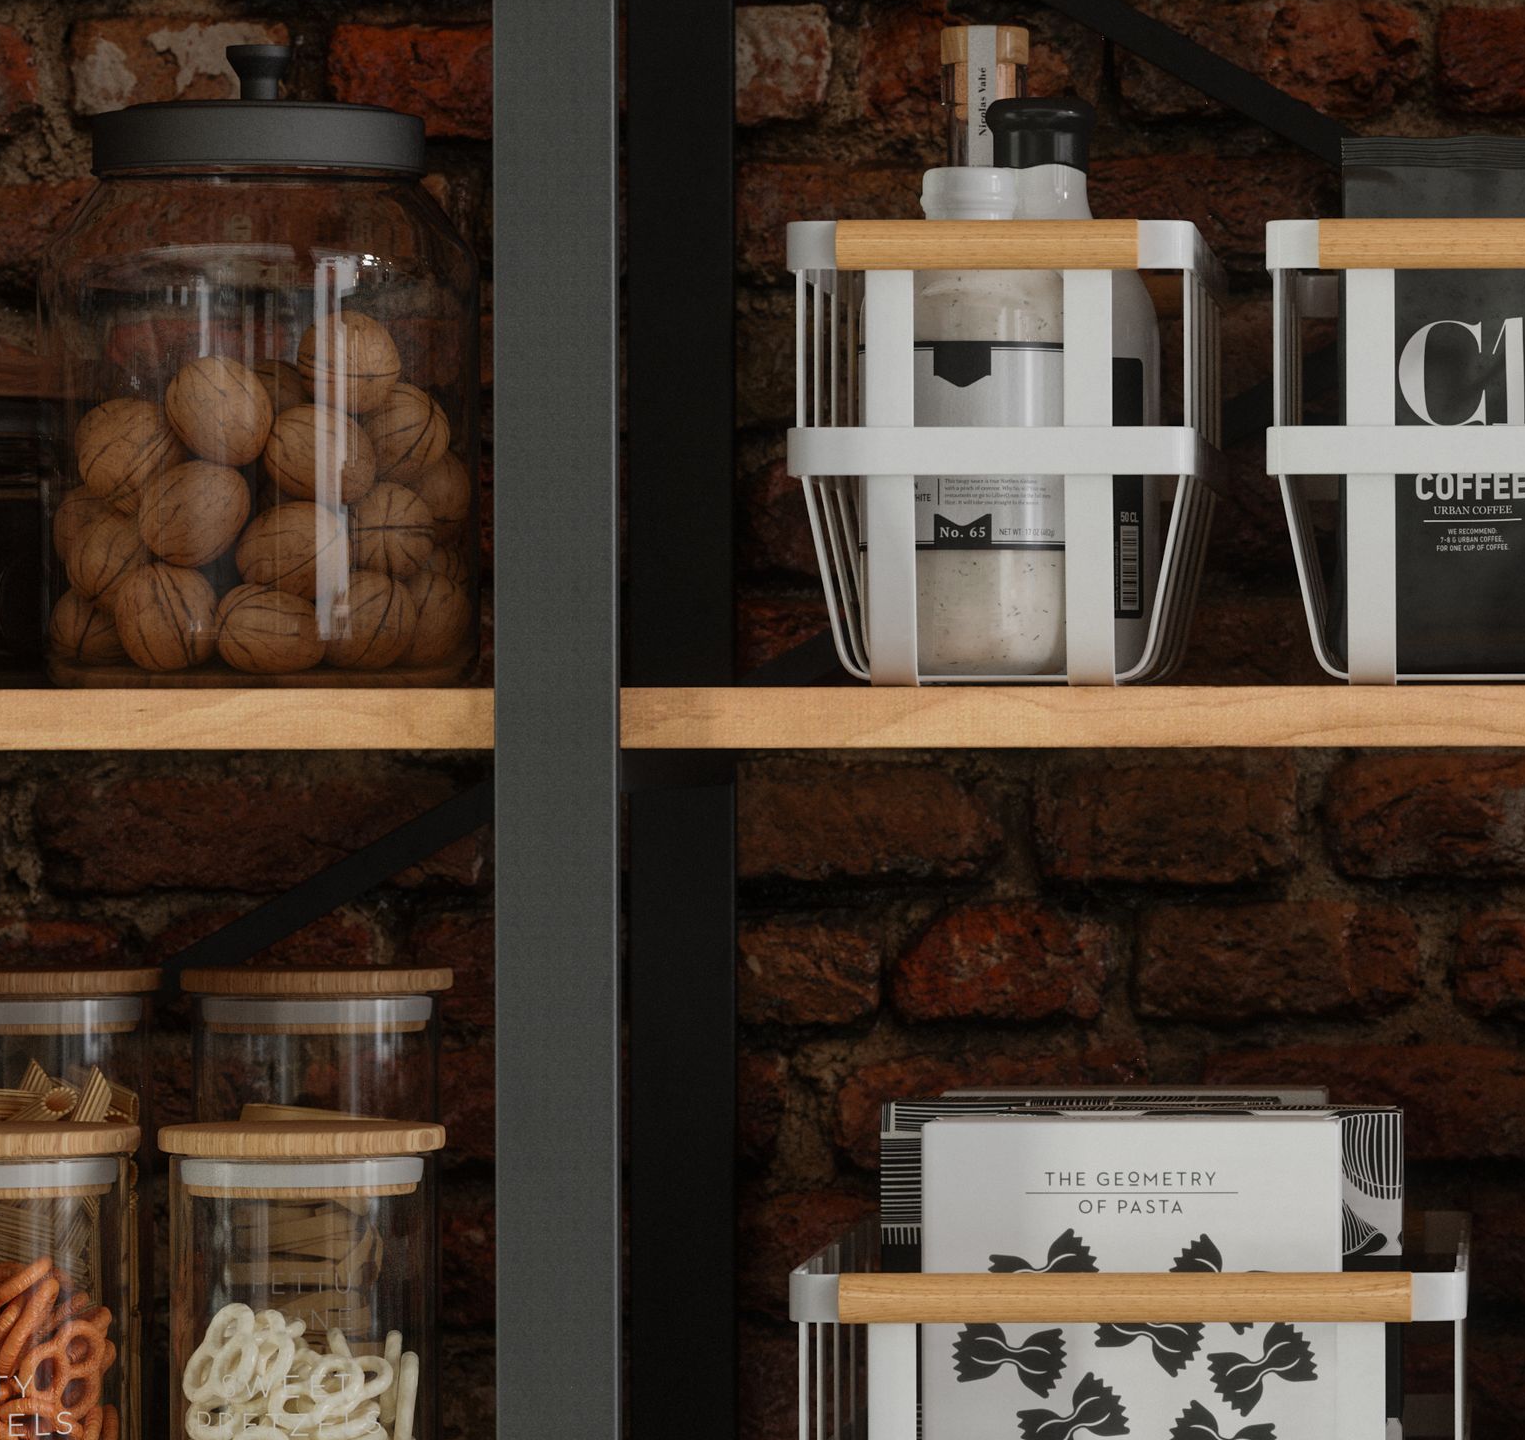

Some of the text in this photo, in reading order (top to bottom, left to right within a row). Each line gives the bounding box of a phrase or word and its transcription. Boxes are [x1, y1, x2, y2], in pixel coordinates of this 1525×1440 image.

[1120, 511, 1129, 522] 50
[1433, 505, 1513, 516] URBAN COFFEE
[939, 526, 987, 538] No. 65
[1045, 1171, 1216, 1187] THE GEOMETRY
[1079, 1199, 1184, 1214] OF PASTA
[222, 1373, 352, 1399] SWEET
